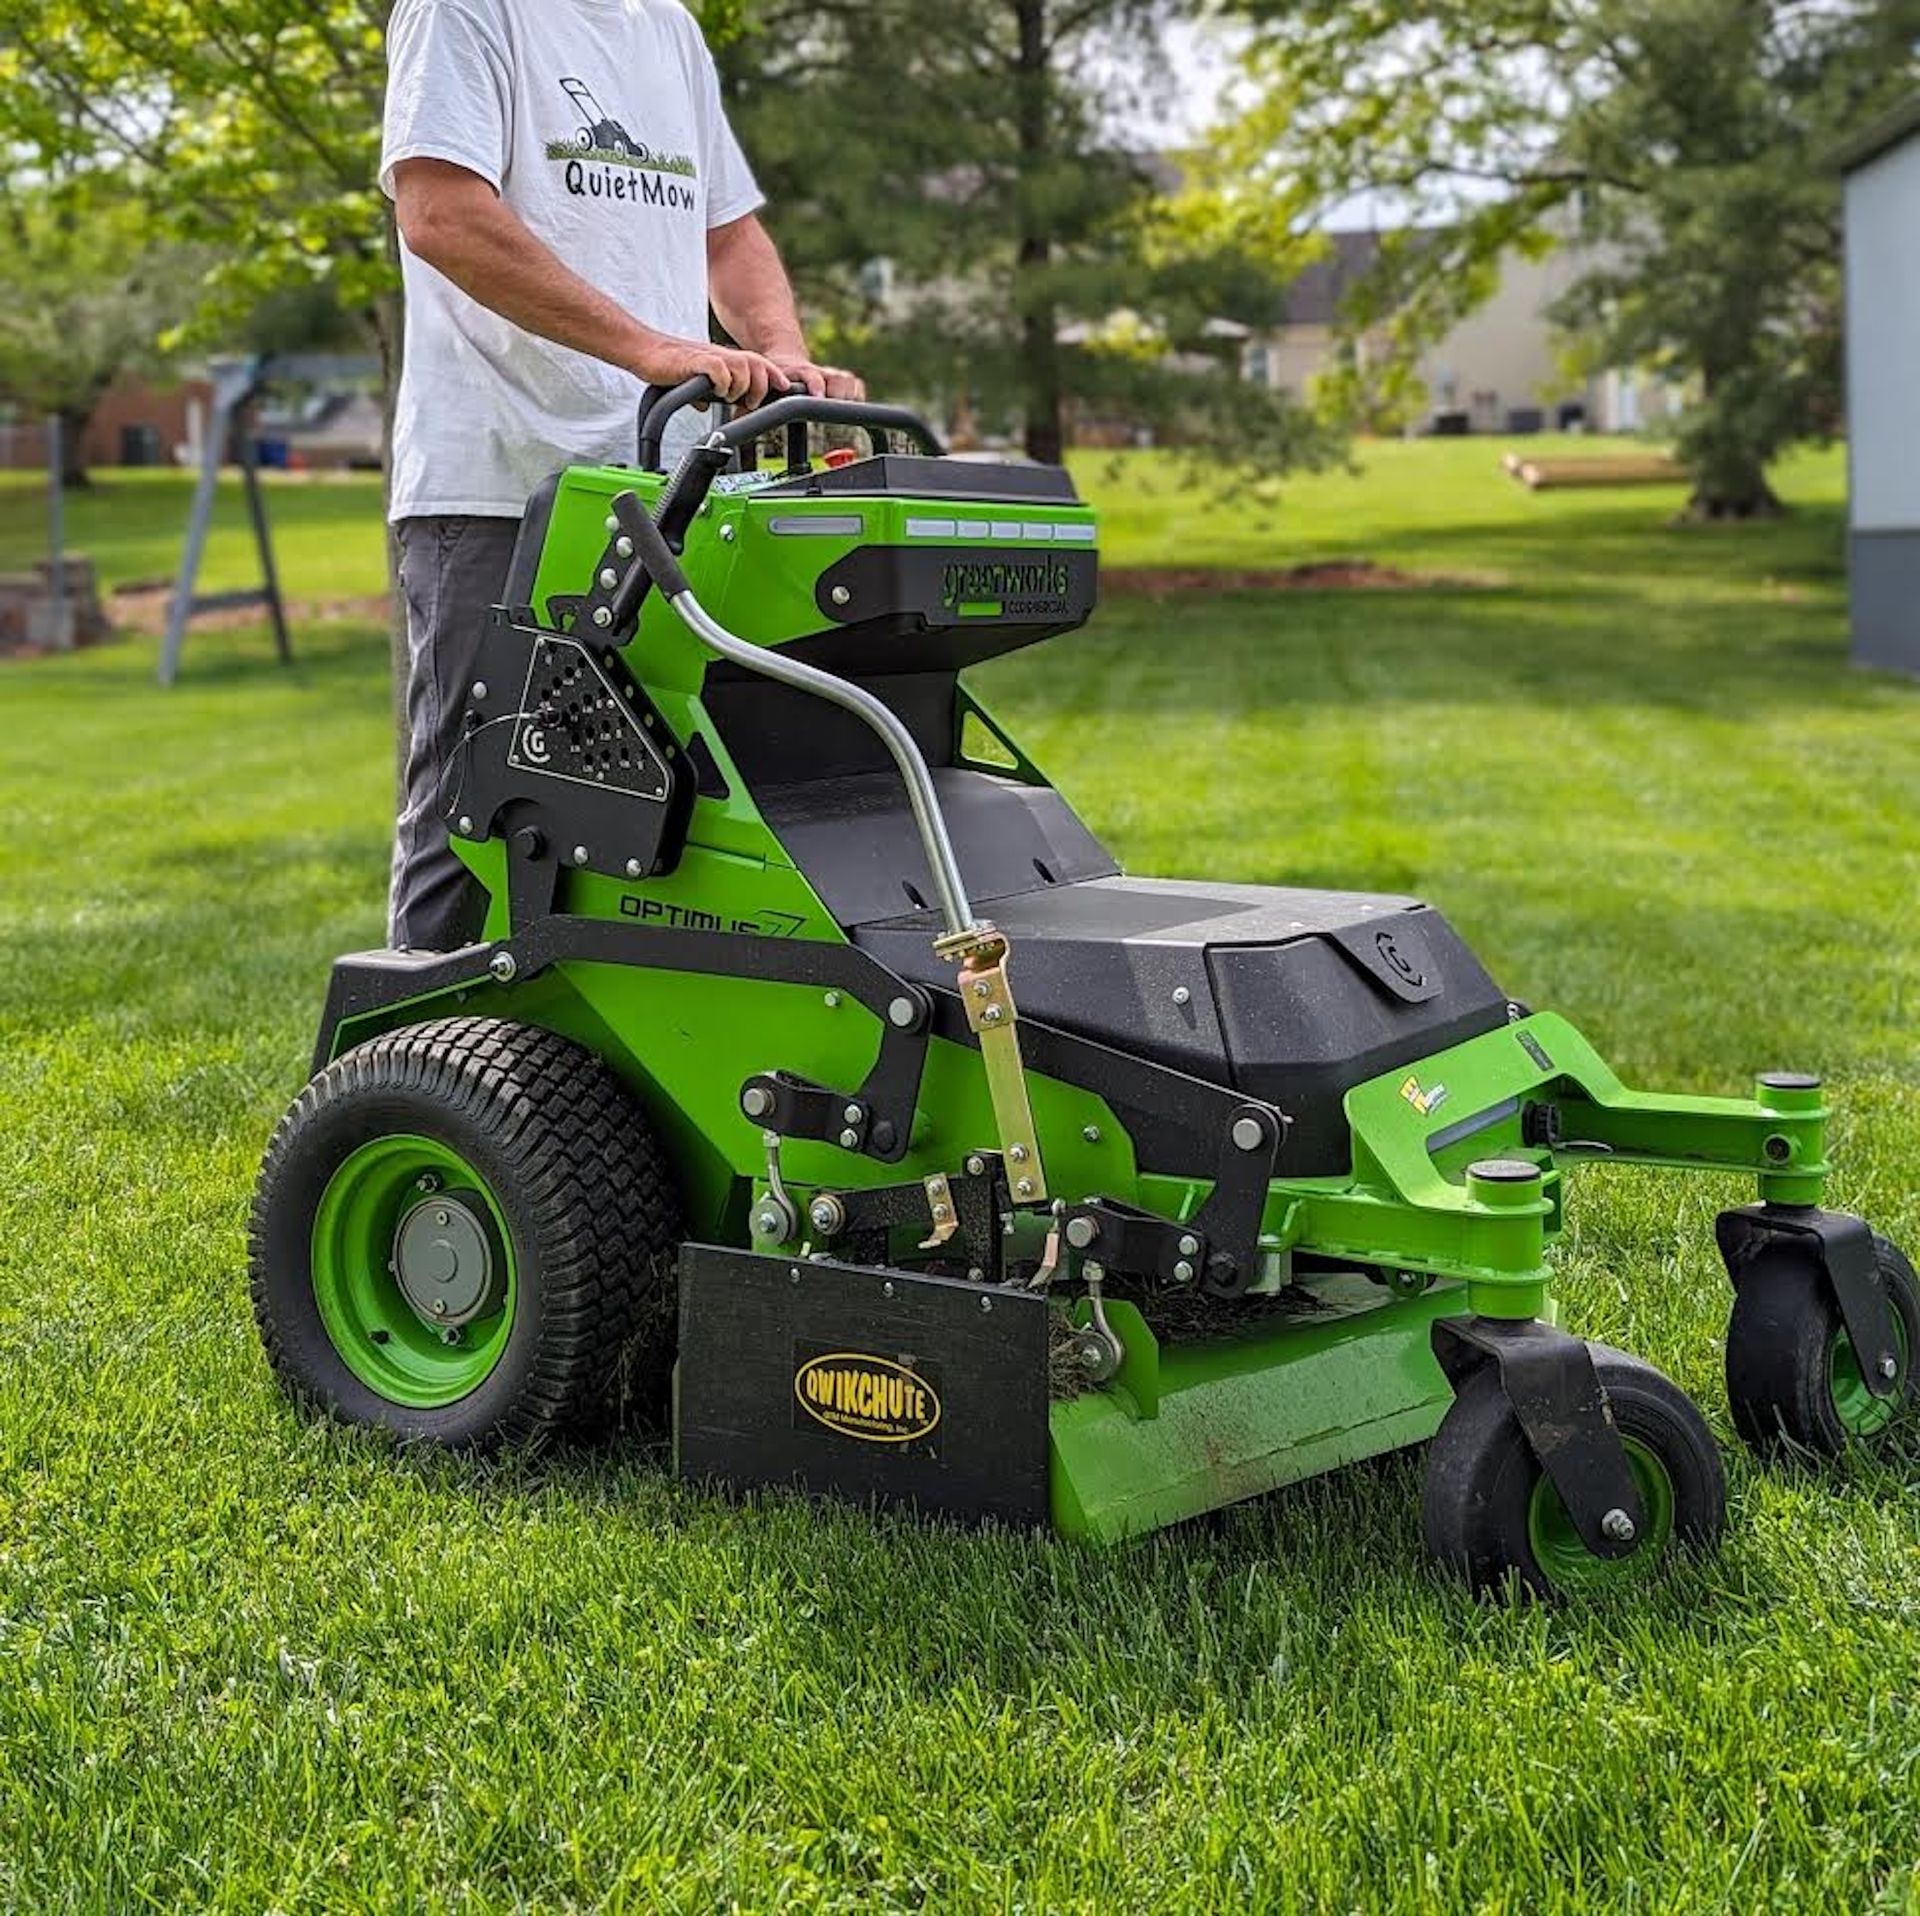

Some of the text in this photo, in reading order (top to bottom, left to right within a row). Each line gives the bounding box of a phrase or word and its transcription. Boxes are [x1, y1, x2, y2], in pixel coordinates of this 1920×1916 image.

[565, 160, 695, 211] QuietMow
[944, 554, 1069, 607] greenworks
[806, 1367, 926, 1420] QWIKCHUTE
